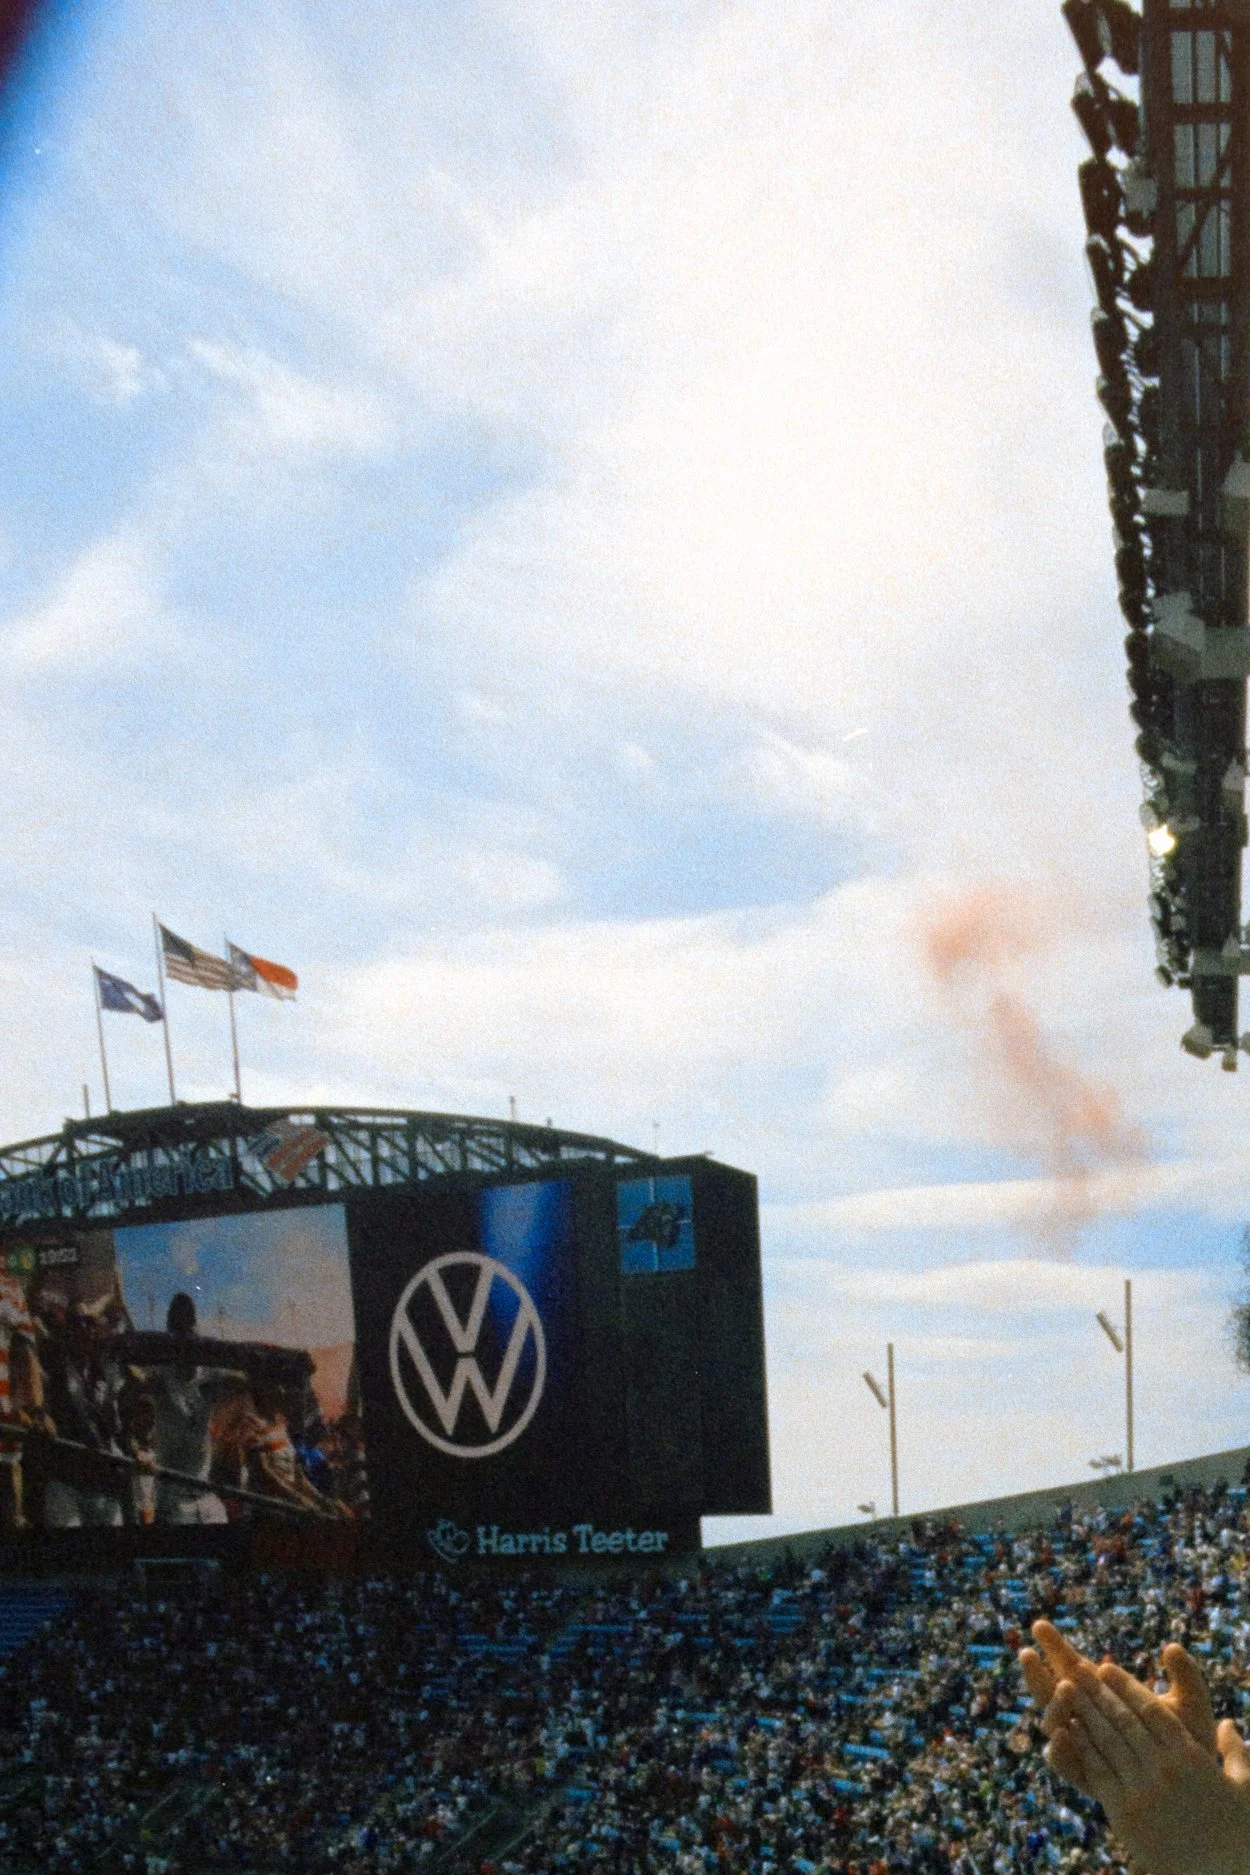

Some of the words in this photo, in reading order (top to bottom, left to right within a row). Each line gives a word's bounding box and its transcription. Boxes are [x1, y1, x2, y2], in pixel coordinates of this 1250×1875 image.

[0, 1168, 57, 1214] ank
[393, 1260, 540, 1440] VW
[475, 1524, 568, 1555] Harris
[572, 1522, 670, 1554] Teeter
